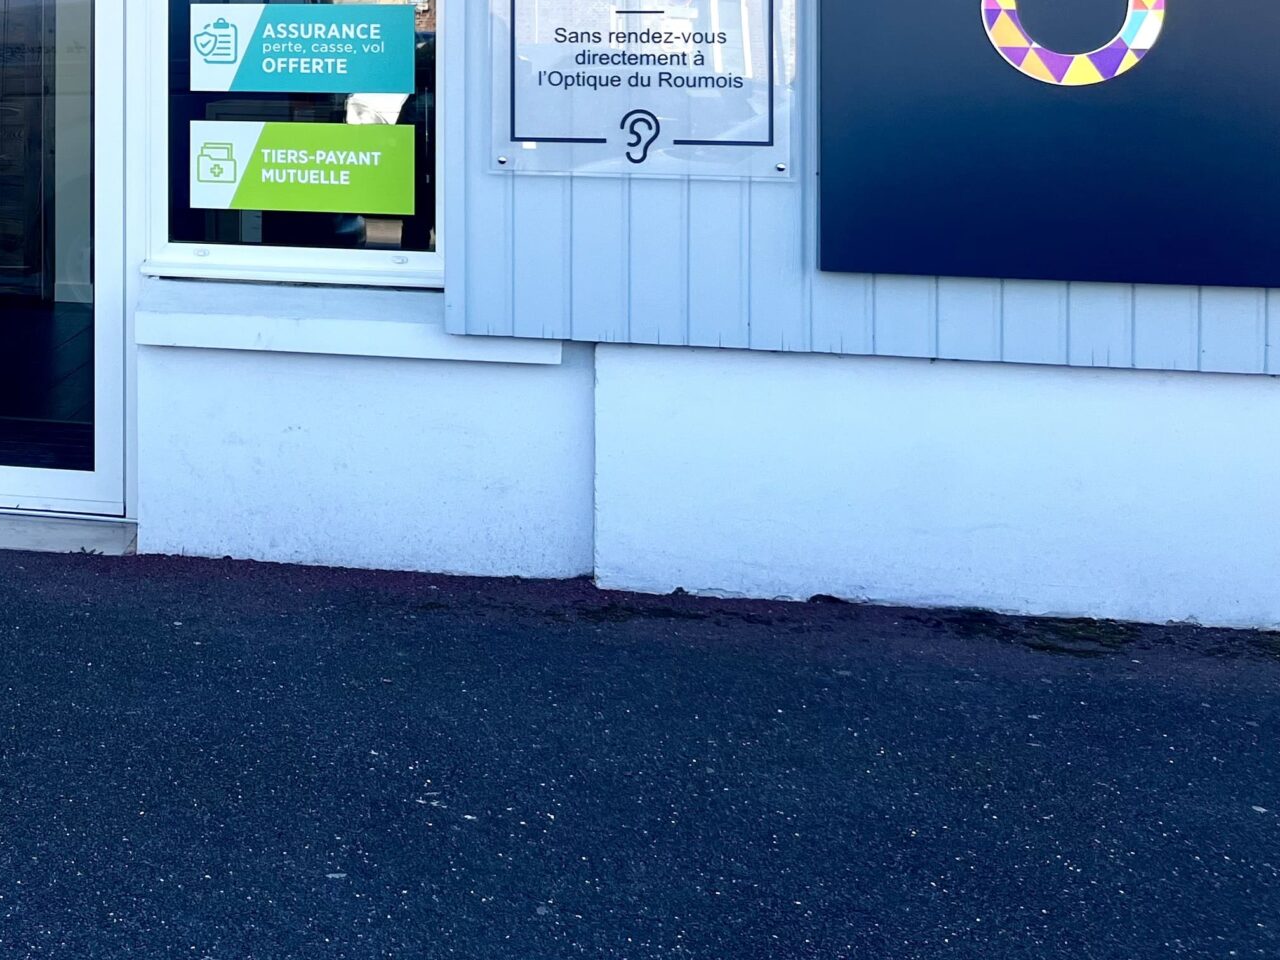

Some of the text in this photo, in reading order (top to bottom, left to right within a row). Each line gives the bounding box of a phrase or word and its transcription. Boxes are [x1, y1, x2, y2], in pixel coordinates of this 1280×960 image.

[262, 24, 381, 39] ASSURANCE
[554, 28, 727, 44] Sans rendez-vous
[262, 41, 384, 54] perte, casse, vol
[262, 58, 347, 74] OFFERTE
[575, 50, 705, 66] directement à
[627, 72, 651, 88] du
[658, 72, 744, 88] Roumois
[261, 149, 381, 165] TIERS-PAYANT
[261, 169, 350, 185] MUTUELLE
